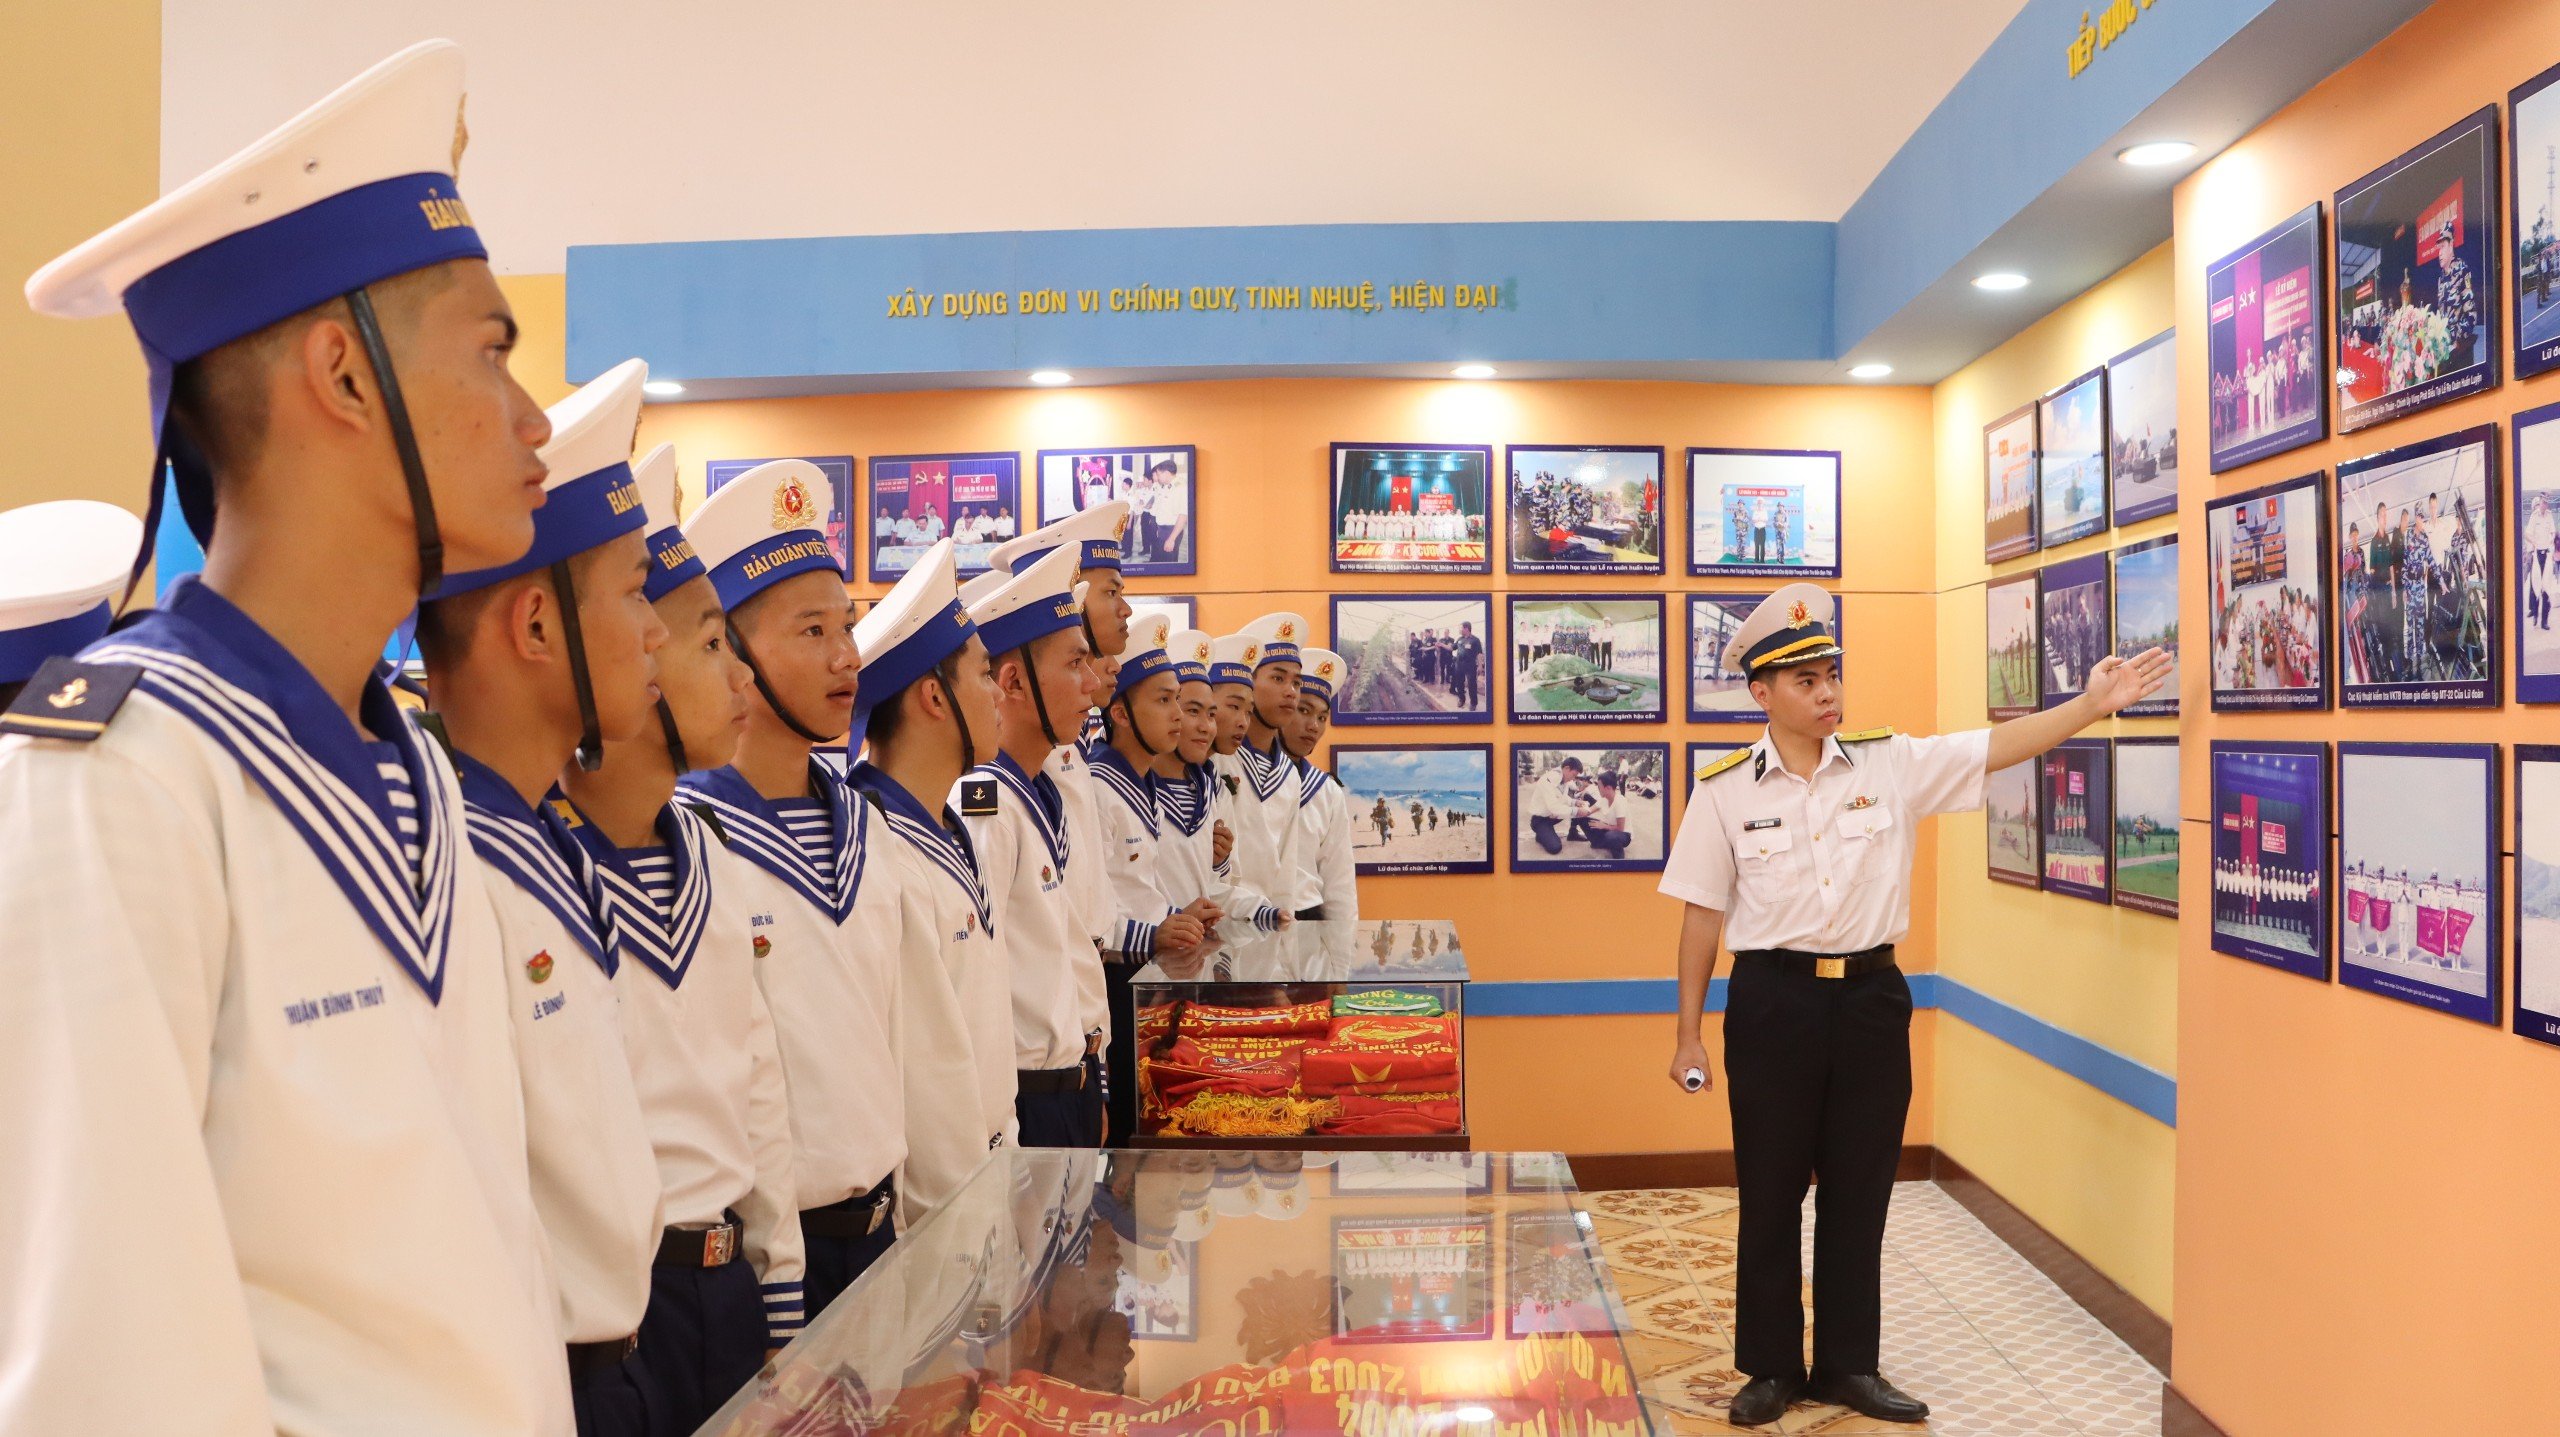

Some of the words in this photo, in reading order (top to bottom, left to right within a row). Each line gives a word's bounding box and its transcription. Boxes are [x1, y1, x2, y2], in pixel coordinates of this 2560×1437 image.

[419, 188, 462, 231] HẢI
[887, 287, 934, 317] XÂY
[943, 289, 1007, 320] DỰNG
[1019, 287, 1067, 314] ĐƠN
[1077, 289, 1100, 312] VI
[1109, 282, 1180, 312] CHÍNH
[1189, 286, 1238, 312] QUY,
[1310, 280, 1382, 313] NHUỆ,
[1390, 280, 1444, 313] HIỆN
[1454, 284, 1497, 312] ĐẠI
[2542, 348, 2552, 360] Lữ
[606, 480, 635, 515] HẢI
[659, 542, 686, 570] HẢI
[743, 555, 771, 580] HẢI
[768, 542, 807, 567] QUÂN
[751, 913, 764, 927] ĐỨC
[321, 991, 354, 1017] BÌNH
[1309, 1357, 1407, 1395] 2003
